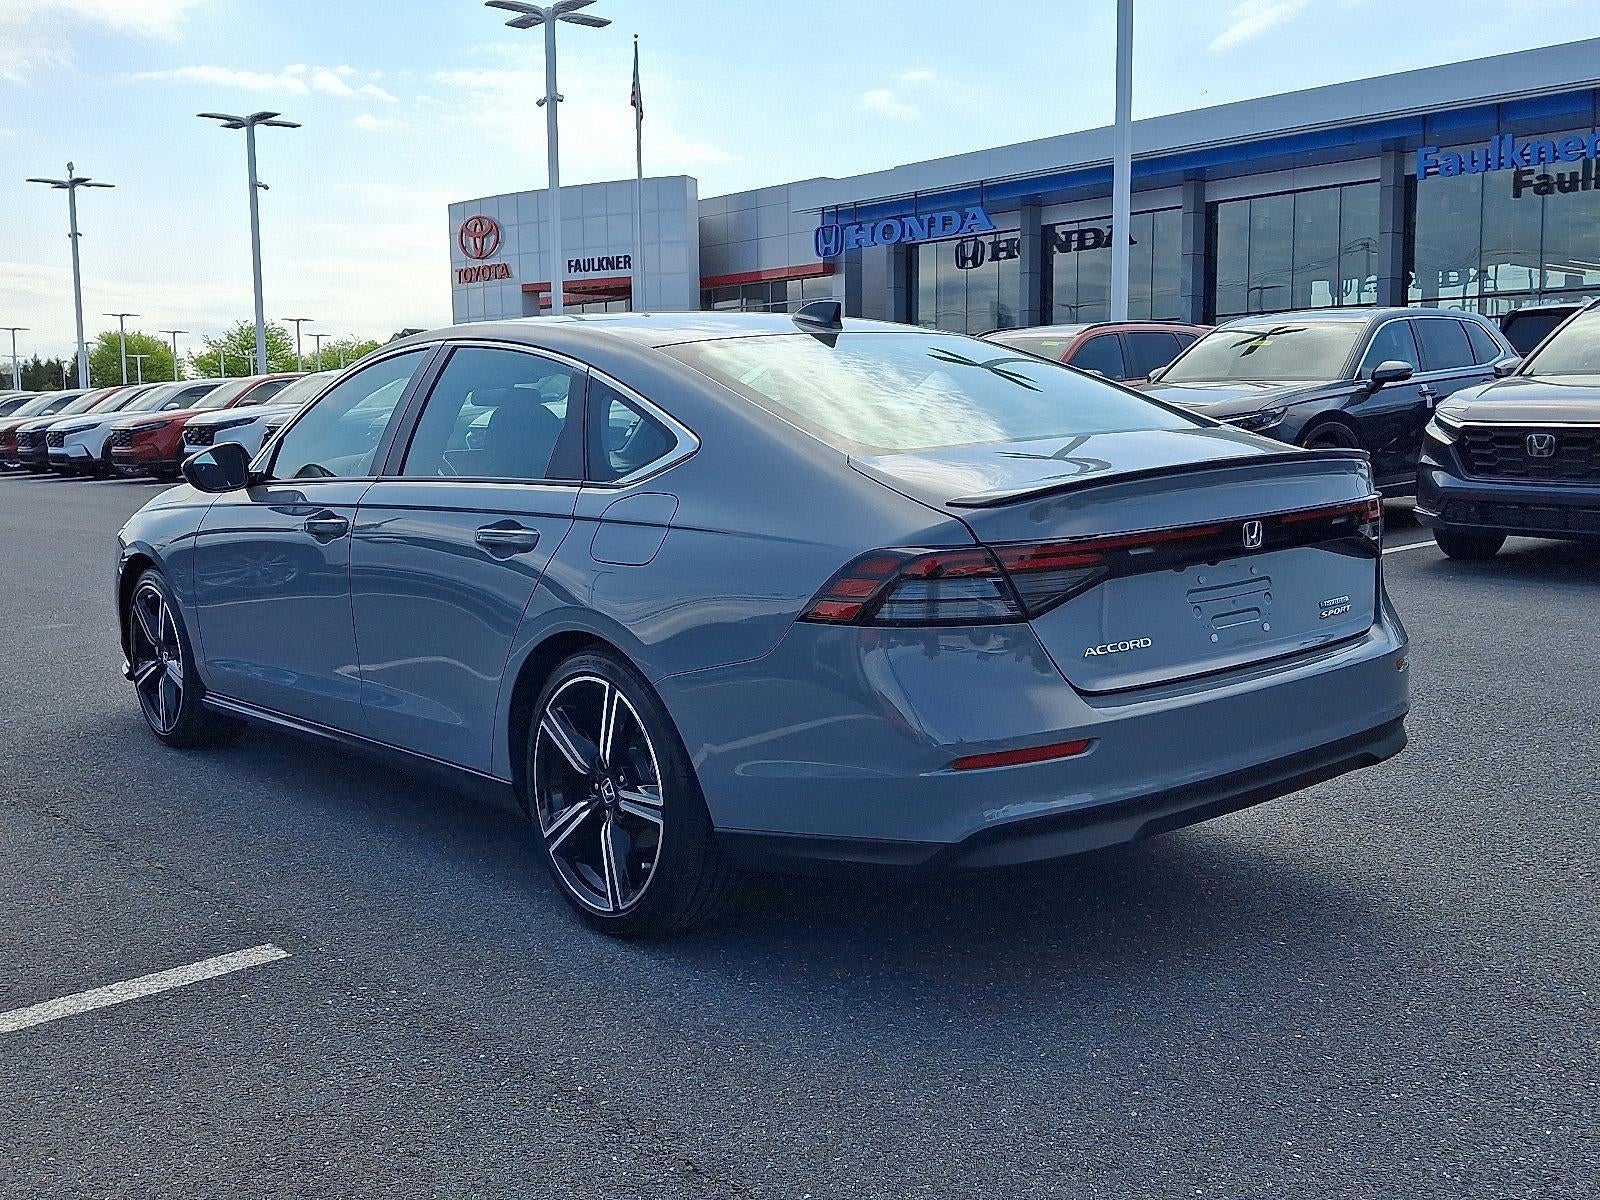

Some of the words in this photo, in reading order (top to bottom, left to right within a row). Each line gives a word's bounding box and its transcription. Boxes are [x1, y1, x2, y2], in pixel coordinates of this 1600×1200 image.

[1416, 133, 1600, 181] Faulkner
[844, 206, 995, 249] HONDA
[454, 263, 511, 284] TOYOTA
[567, 254, 632, 274] FAULKNER
[1320, 604, 1352, 619] SPORT
[1083, 636, 1152, 658] ACCORD
